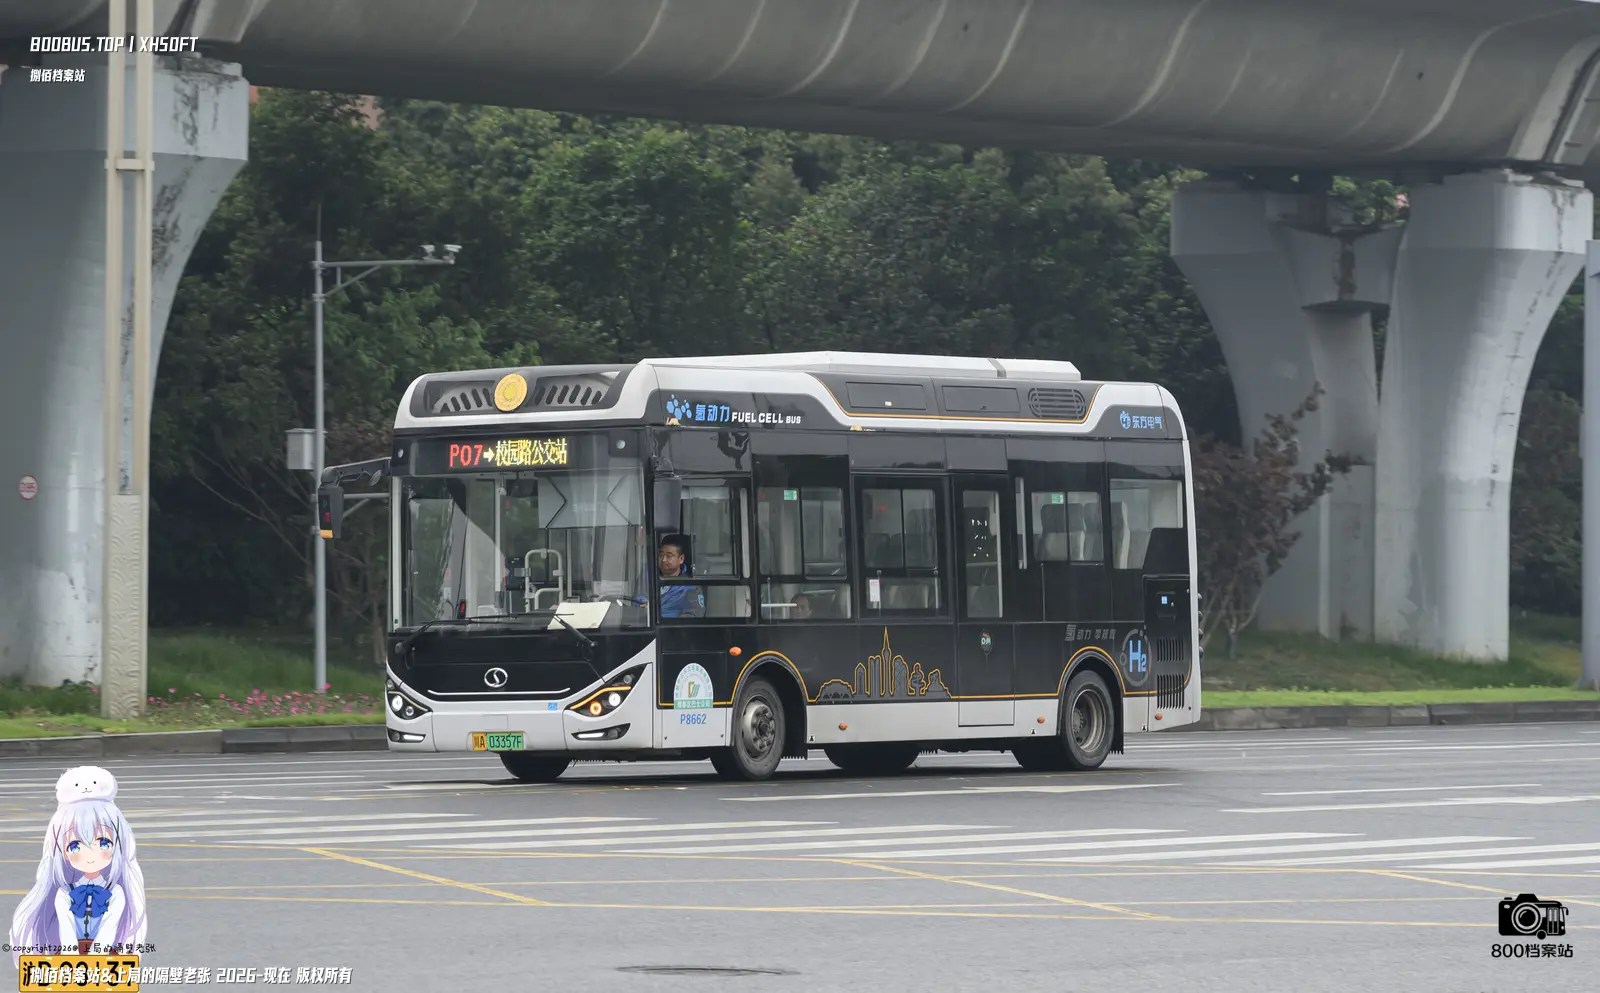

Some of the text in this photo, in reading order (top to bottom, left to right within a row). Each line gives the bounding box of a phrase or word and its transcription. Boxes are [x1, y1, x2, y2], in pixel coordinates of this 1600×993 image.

[695, 404, 730, 422] 氢动力
[731, 411, 802, 424] FUEL CELL BUS
[1132, 415, 1163, 430] 东方电气
[449, 437, 568, 468] P07 校园路公交站
[680, 713, 707, 725] P8662
[489, 735, 522, 749] 03357F
